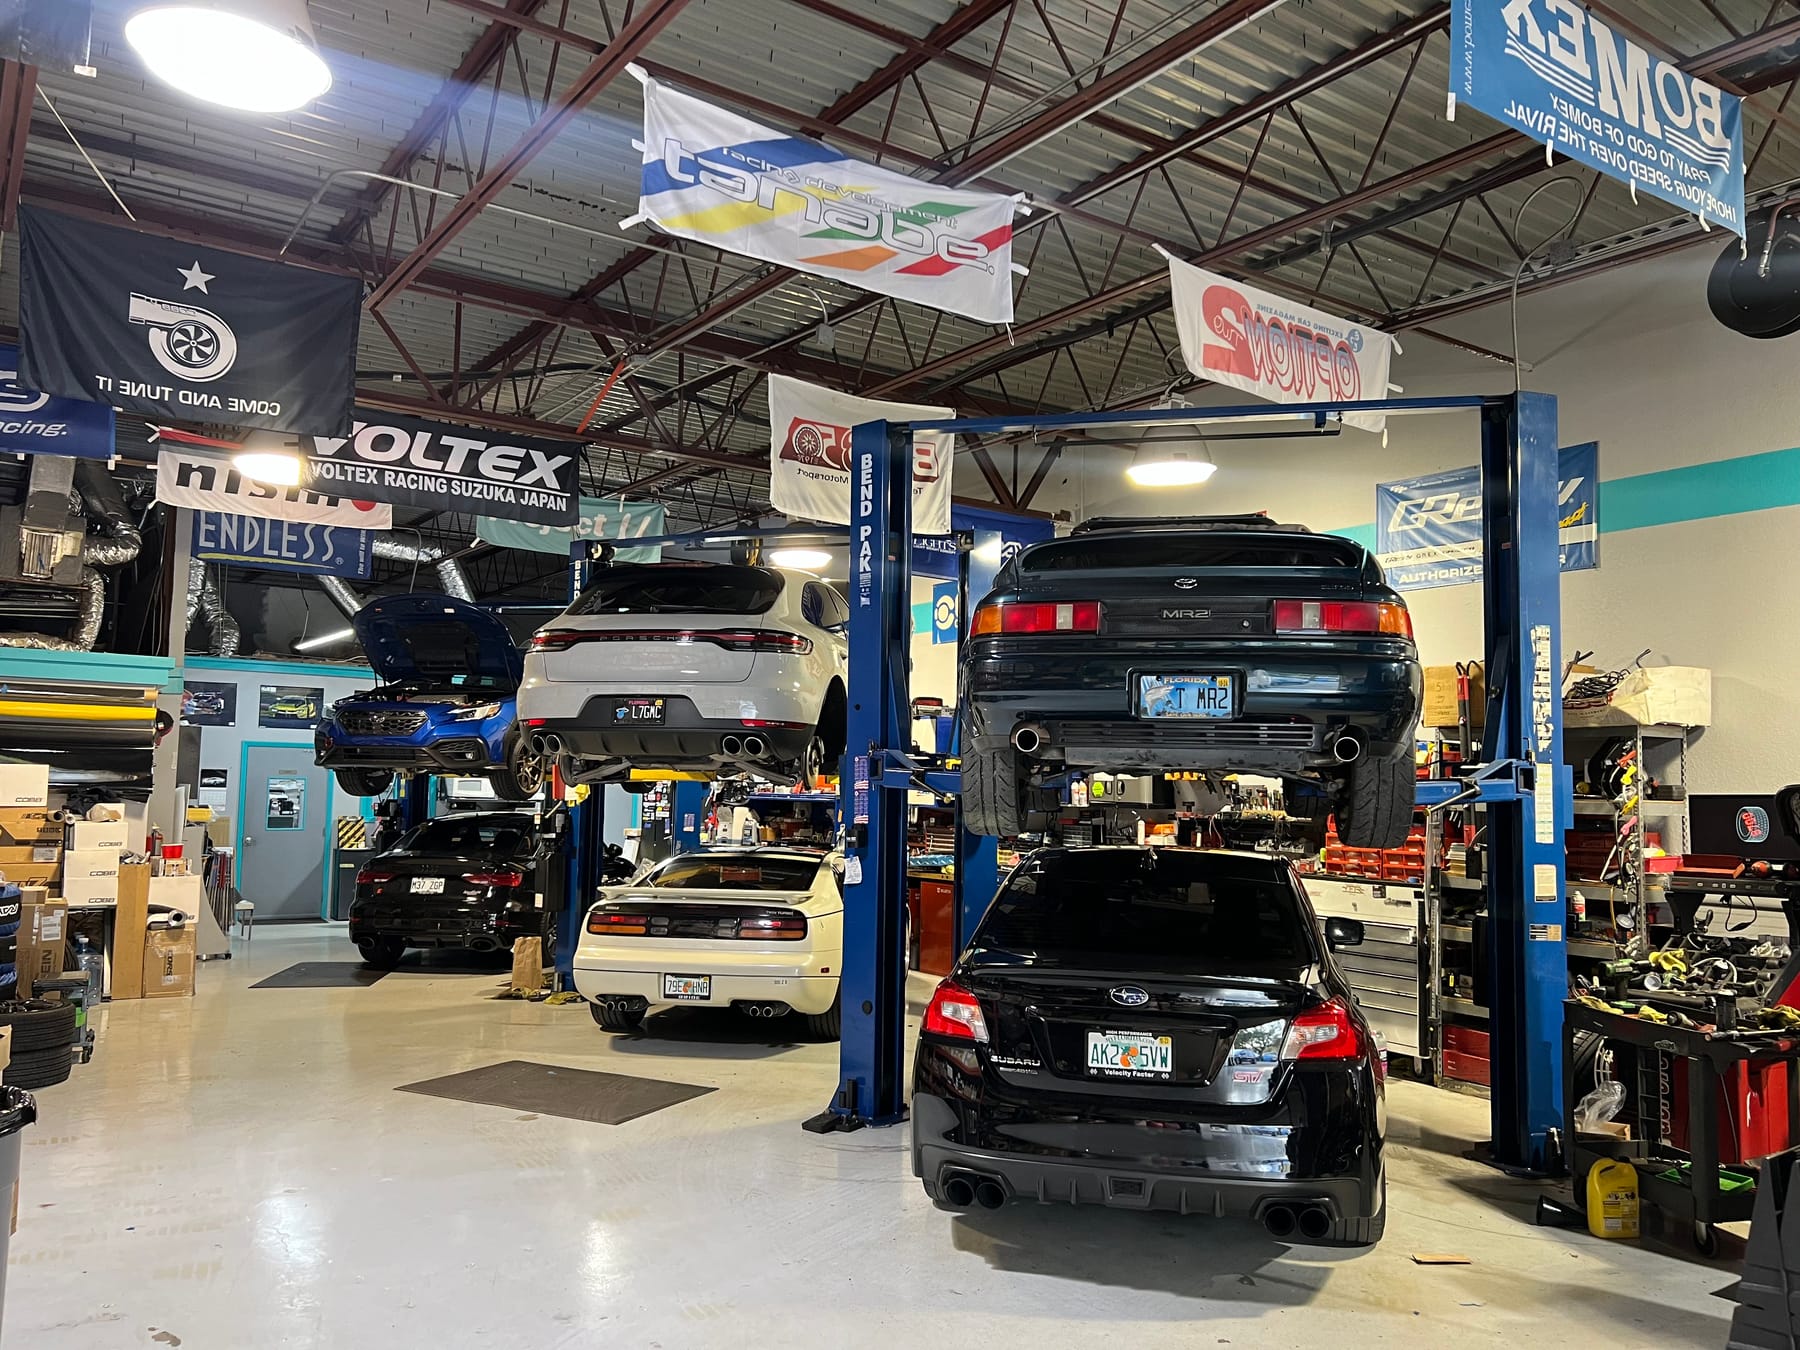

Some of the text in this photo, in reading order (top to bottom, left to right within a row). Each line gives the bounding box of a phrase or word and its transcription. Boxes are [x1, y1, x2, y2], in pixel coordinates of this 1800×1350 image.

[721, 146, 960, 230] racing development
[313, 421, 573, 490] VOLTEX
[311, 462, 567, 512] VOLTEX RACING SUZUKA JAPAN
[859, 453, 873, 517] BEND
[198, 511, 335, 563] ENDLESS
[859, 525, 873, 573] PAK
[1162, 609, 1210, 619] MR2
[1163, 677, 1209, 685] FLORIDA
[1175, 687, 1228, 710] T MR2
[631, 705, 662, 720] L7GMC
[667, 979, 683, 993] 79E
[990, 1055, 1041, 1067] SUBARU
[1090, 1043, 1169, 1068] AK2 5VW
[1104, 1068, 1155, 1078] Velocity Factor
